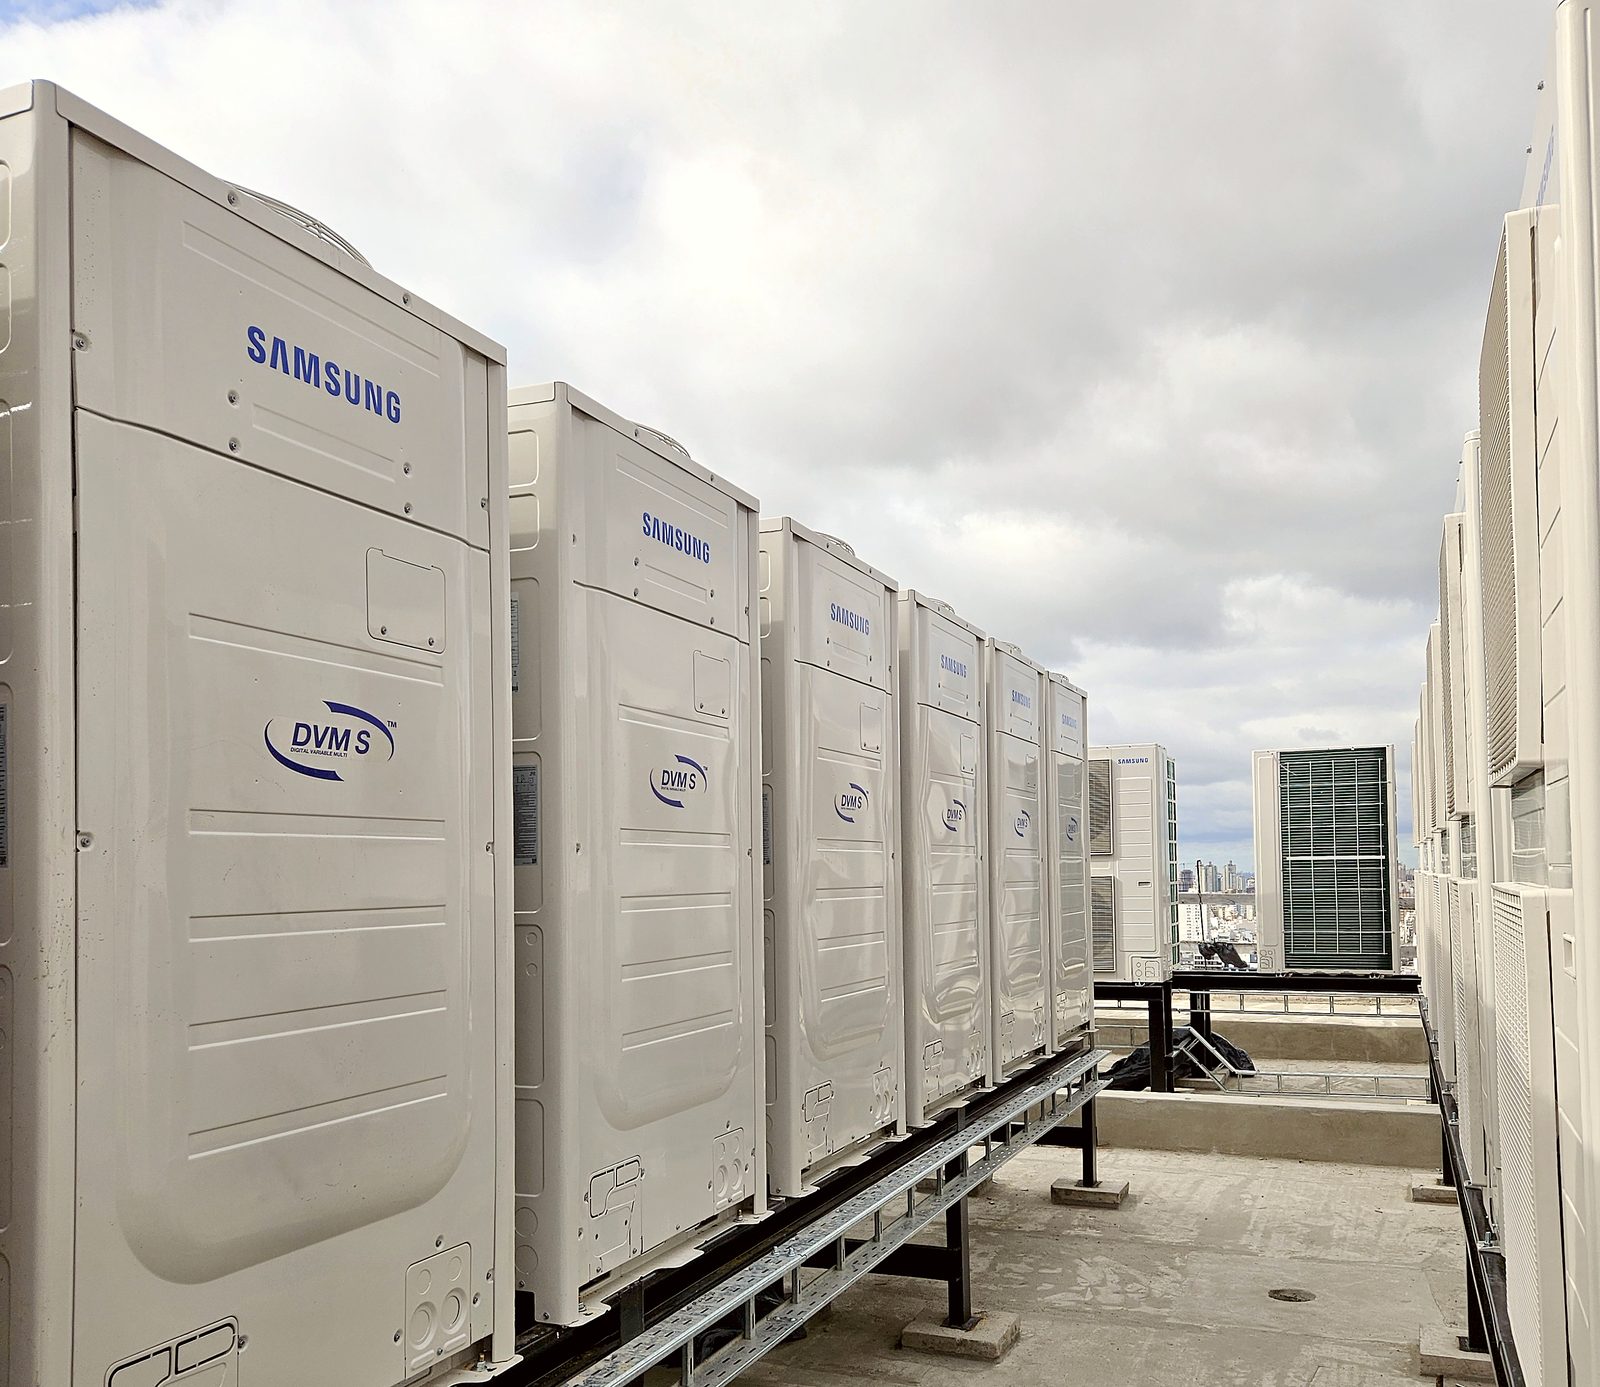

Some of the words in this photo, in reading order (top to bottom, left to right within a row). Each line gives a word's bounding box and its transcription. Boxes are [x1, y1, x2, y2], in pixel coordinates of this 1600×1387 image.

[247, 325, 402, 424] SAMSUNG
[642, 511, 710, 564] SAMSUNG
[830, 602, 870, 636] SAMSUNG
[940, 654, 967, 678] SAMSUNG
[387, 720, 397, 728] TM
[290, 746, 309, 754] DIGITAL
[291, 722, 351, 752] DVM
[354, 729, 371, 755] S
[661, 769, 687, 788] DVM
[688, 773, 696, 790] S
[841, 794, 857, 808] DVM
[857, 796, 862, 809] S
